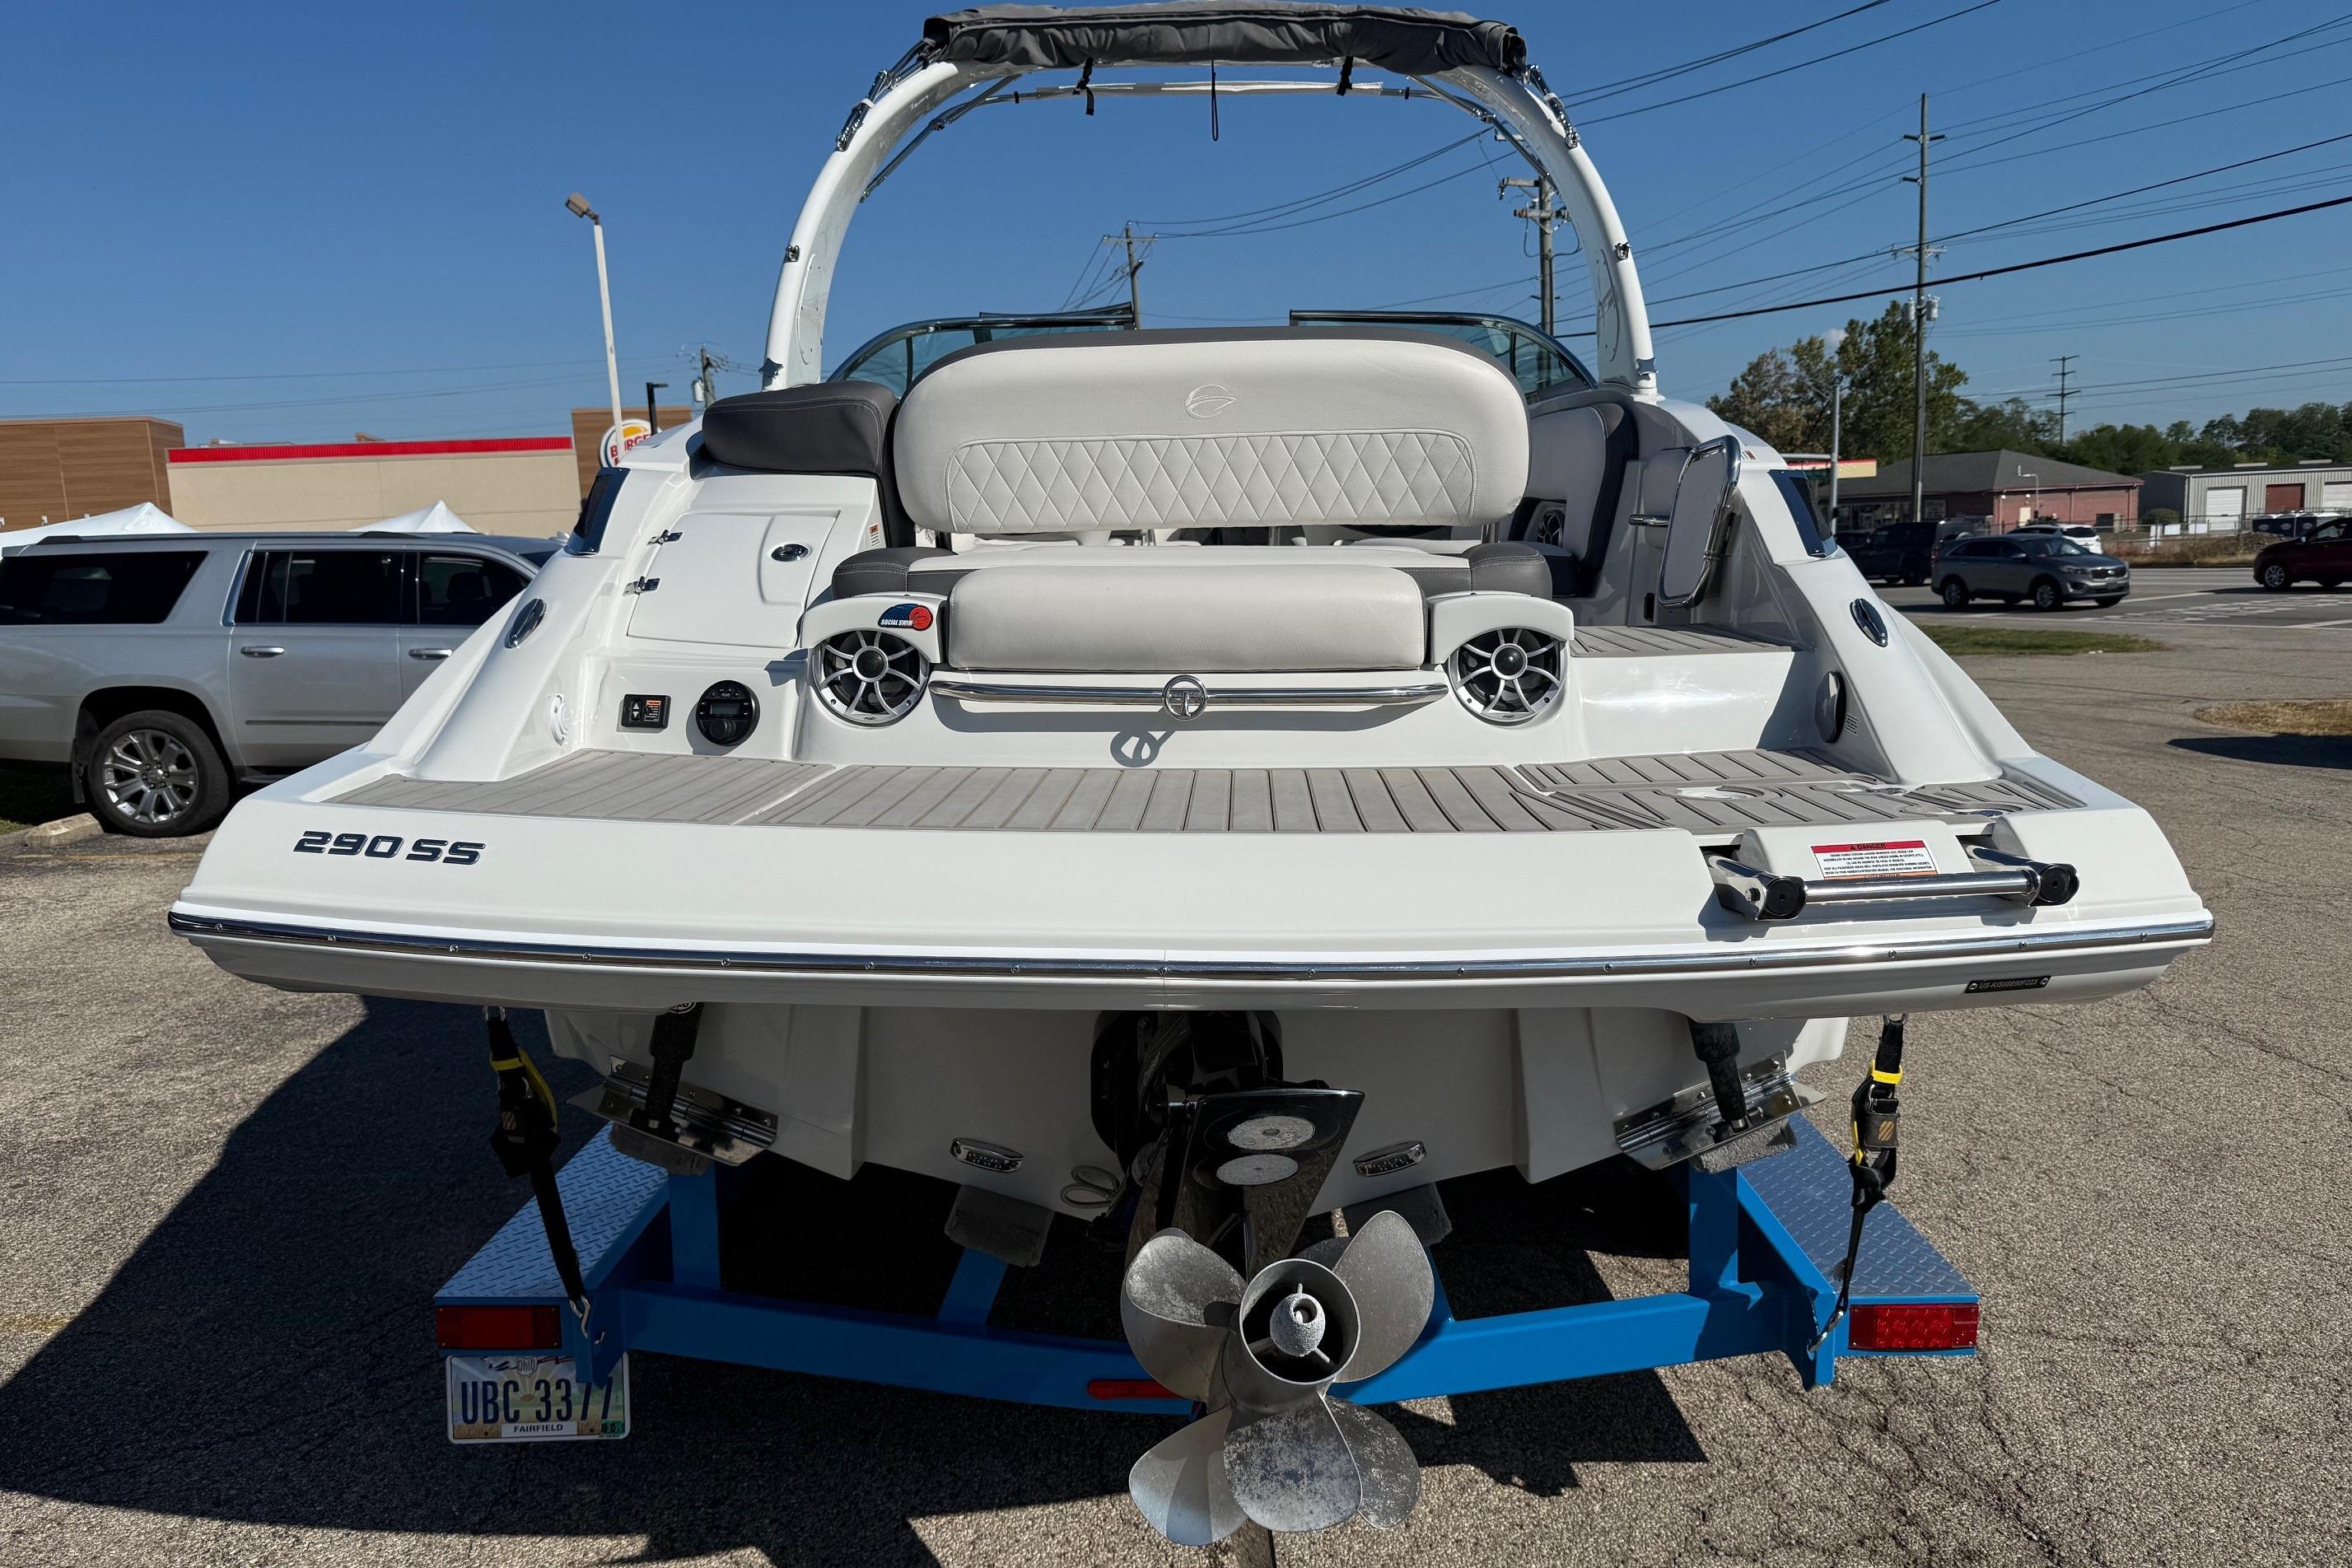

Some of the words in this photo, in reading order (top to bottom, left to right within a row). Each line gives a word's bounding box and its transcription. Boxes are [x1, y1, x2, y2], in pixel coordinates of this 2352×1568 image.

[293, 831, 404, 858] 290
[406, 838, 487, 866] SS
[461, 1379, 520, 1425] UBC
[514, 1424, 563, 1434] FAIRFIELD
